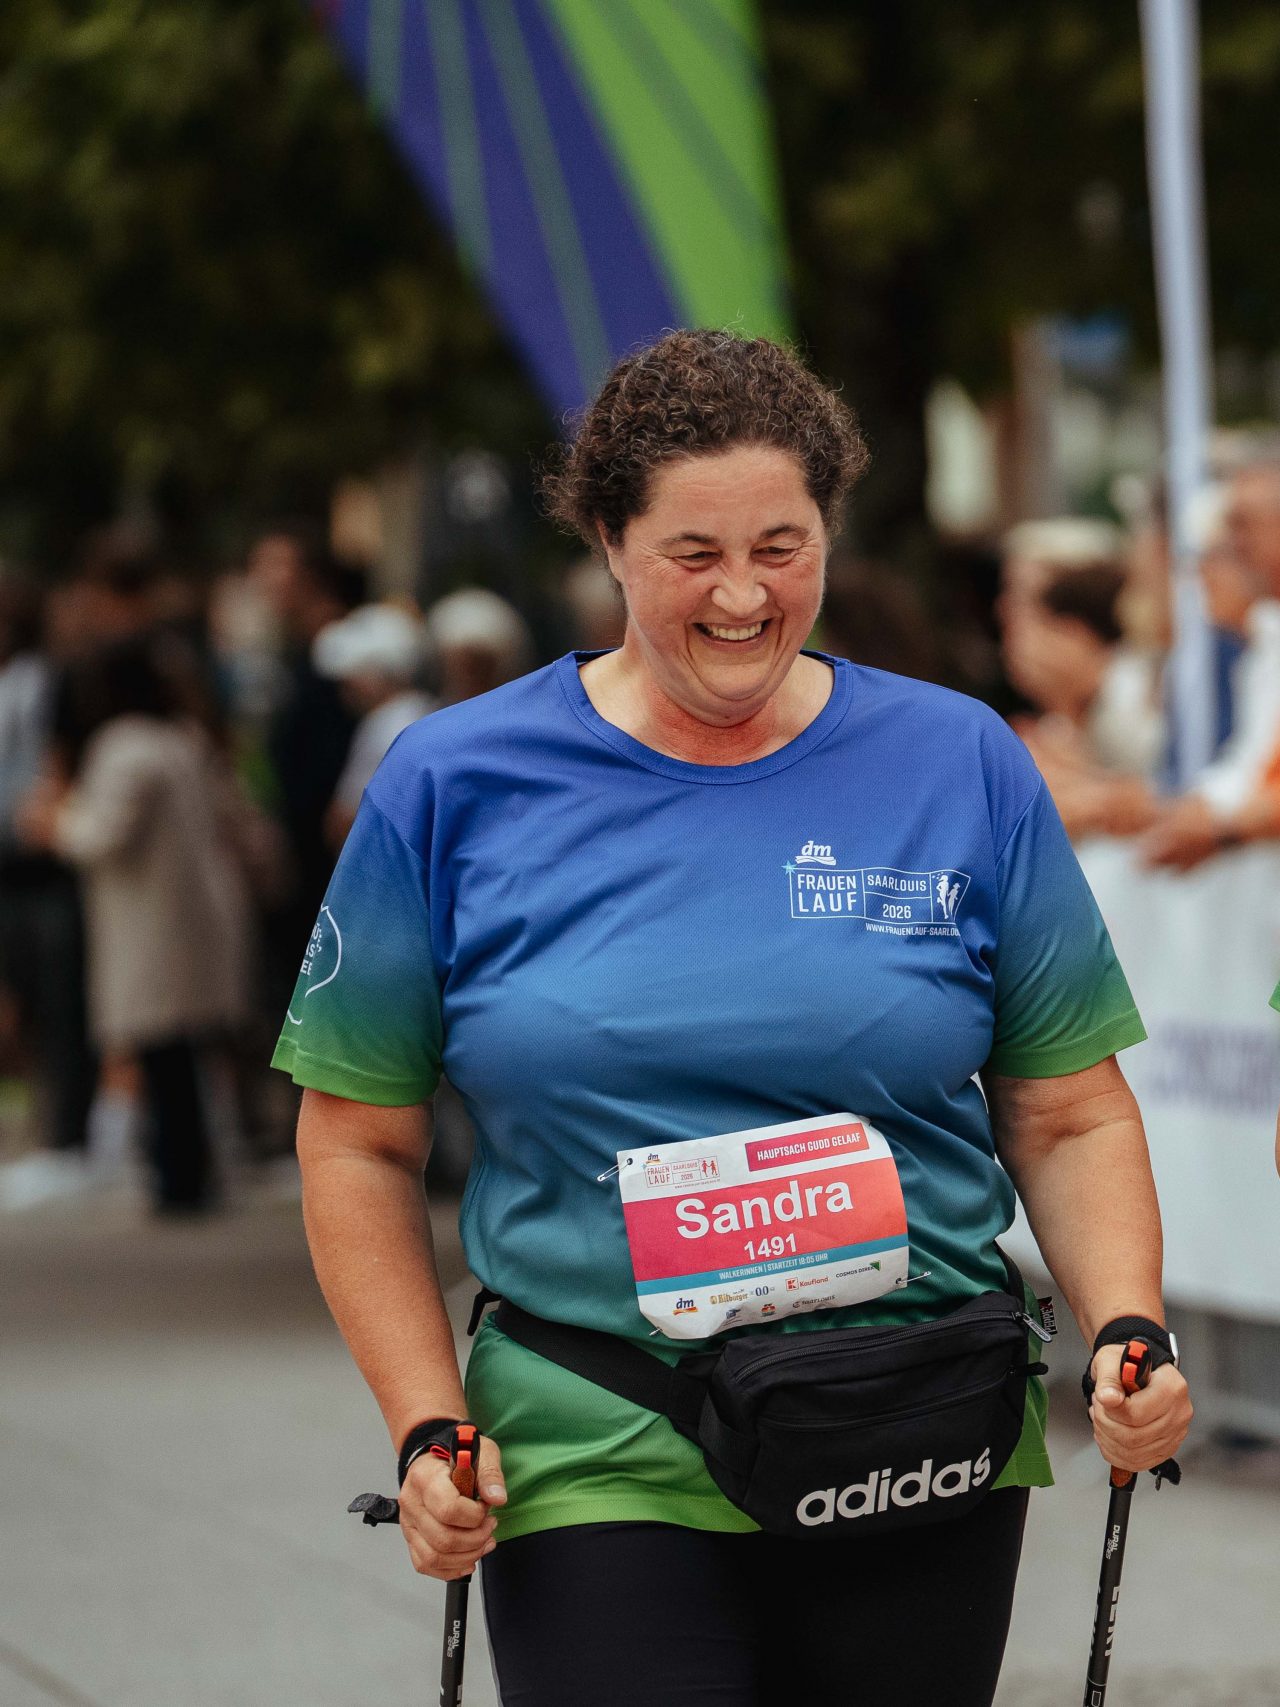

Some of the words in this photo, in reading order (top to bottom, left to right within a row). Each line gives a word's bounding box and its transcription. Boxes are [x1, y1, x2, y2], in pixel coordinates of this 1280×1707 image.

[801, 840, 832, 857] dm
[797, 874, 857, 891] FRAUEN
[867, 874, 927, 892] SAARLOUIS
[798, 892, 857, 912] LAUF
[882, 904, 911, 919] 2026
[757, 1141, 806, 1161] HAUPTSACH
[807, 1137, 830, 1155] GUDD
[832, 1132, 860, 1150] GELAAF
[647, 1167, 670, 1176] FRAUEN
[649, 1174, 671, 1185] LAUF
[675, 1180, 853, 1239] Sandra
[744, 1233, 797, 1261] 1491
[767, 1259, 798, 1272] STARTZEIT
[815, 1253, 828, 1261] UHR
[800, 1277, 829, 1287] Kaufland
[676, 1297, 694, 1310] dm
[796, 1447, 991, 1527] adidas
